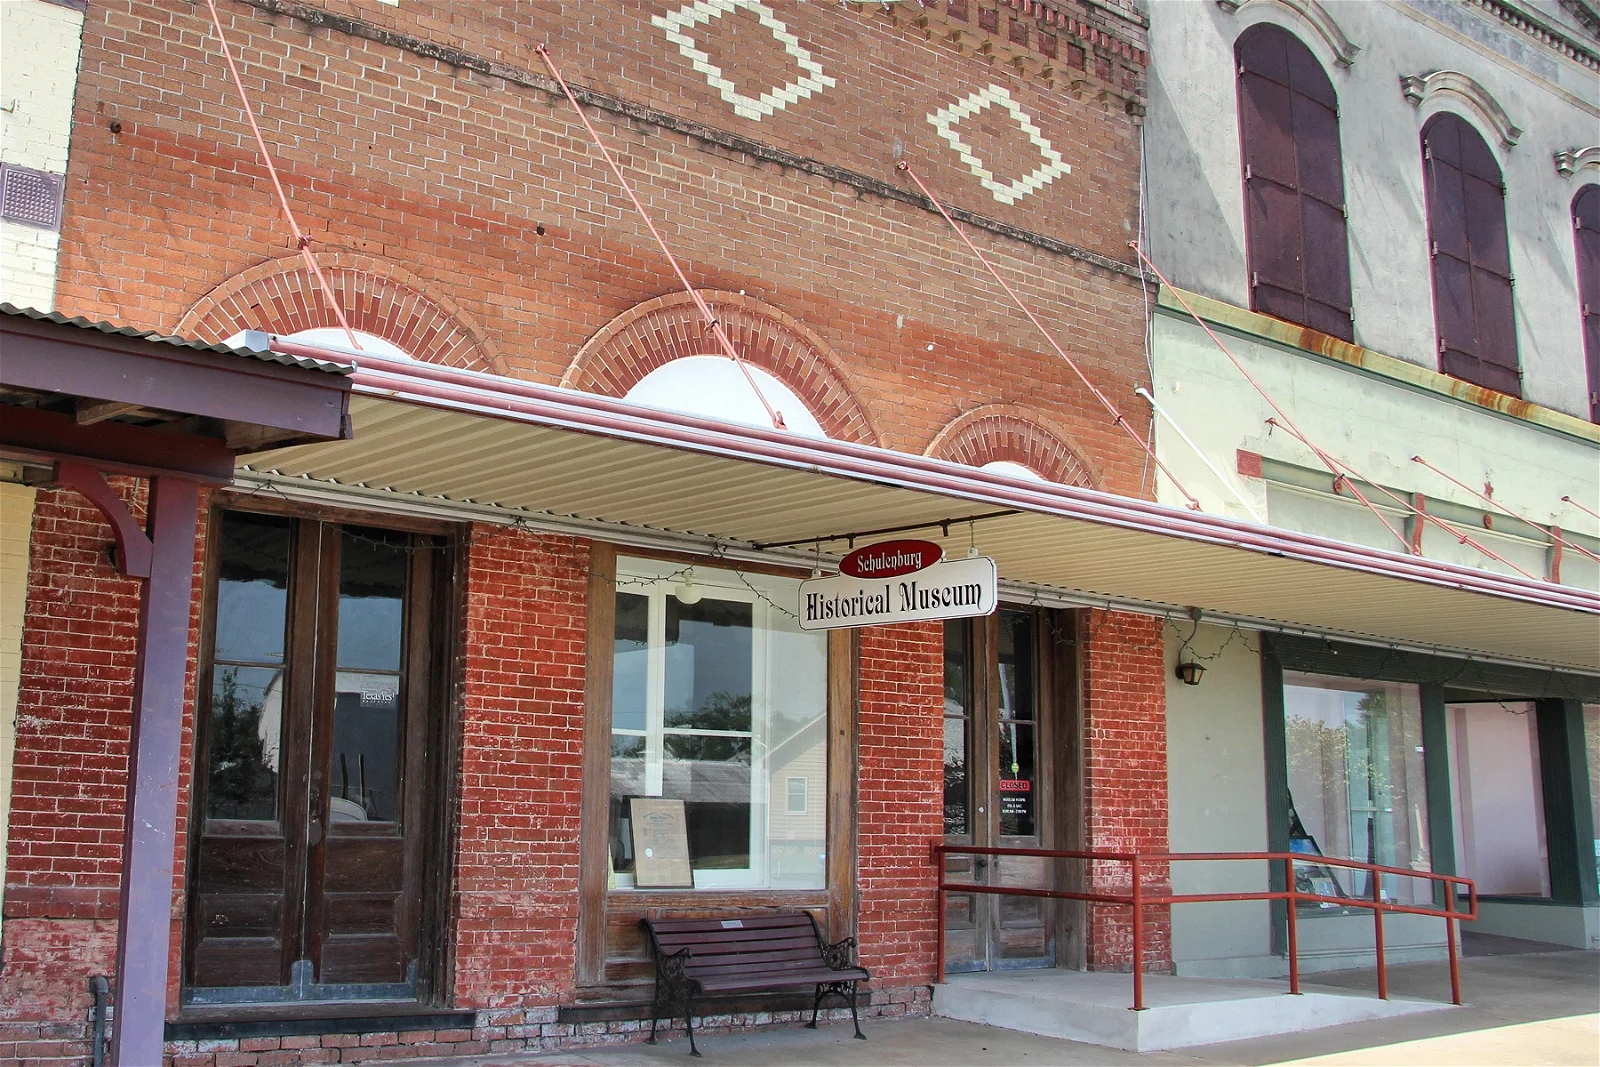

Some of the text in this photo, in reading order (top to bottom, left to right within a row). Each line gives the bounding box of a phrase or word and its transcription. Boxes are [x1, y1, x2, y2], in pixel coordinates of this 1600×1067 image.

[857, 549, 922, 573] Schulenburg
[806, 580, 982, 621] Historical Museum
[1001, 781, 1028, 789] CLOSED
